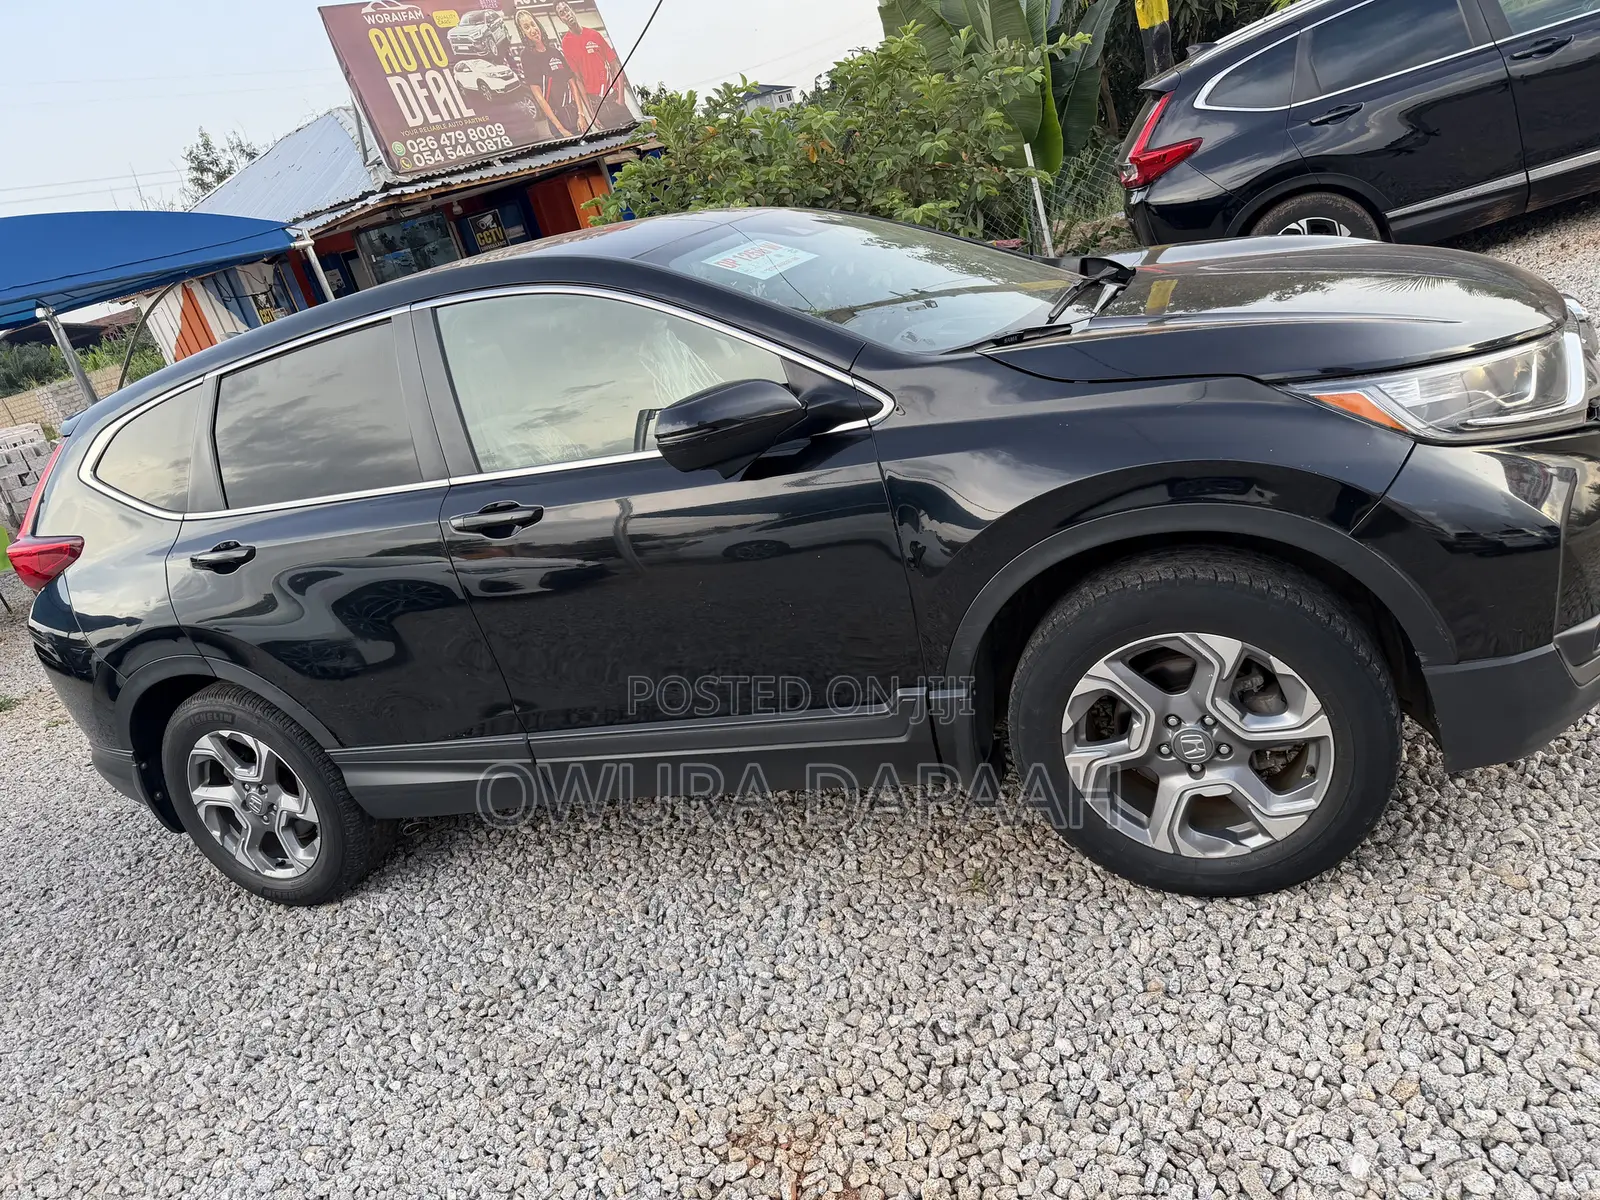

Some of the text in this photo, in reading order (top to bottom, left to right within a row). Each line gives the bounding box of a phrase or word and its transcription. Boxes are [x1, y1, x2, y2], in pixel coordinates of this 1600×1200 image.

[363, 10, 424, 25] WORAIFAM
[368, 23, 449, 74] AUTO
[386, 68, 476, 128] DEAL
[401, 116, 490, 137] YOUR RELIABLE AUTO PARTNER
[406, 123, 505, 153] 026 479 8009
[413, 136, 513, 167] 054 544 0878
[476, 227, 504, 246] CCTV
